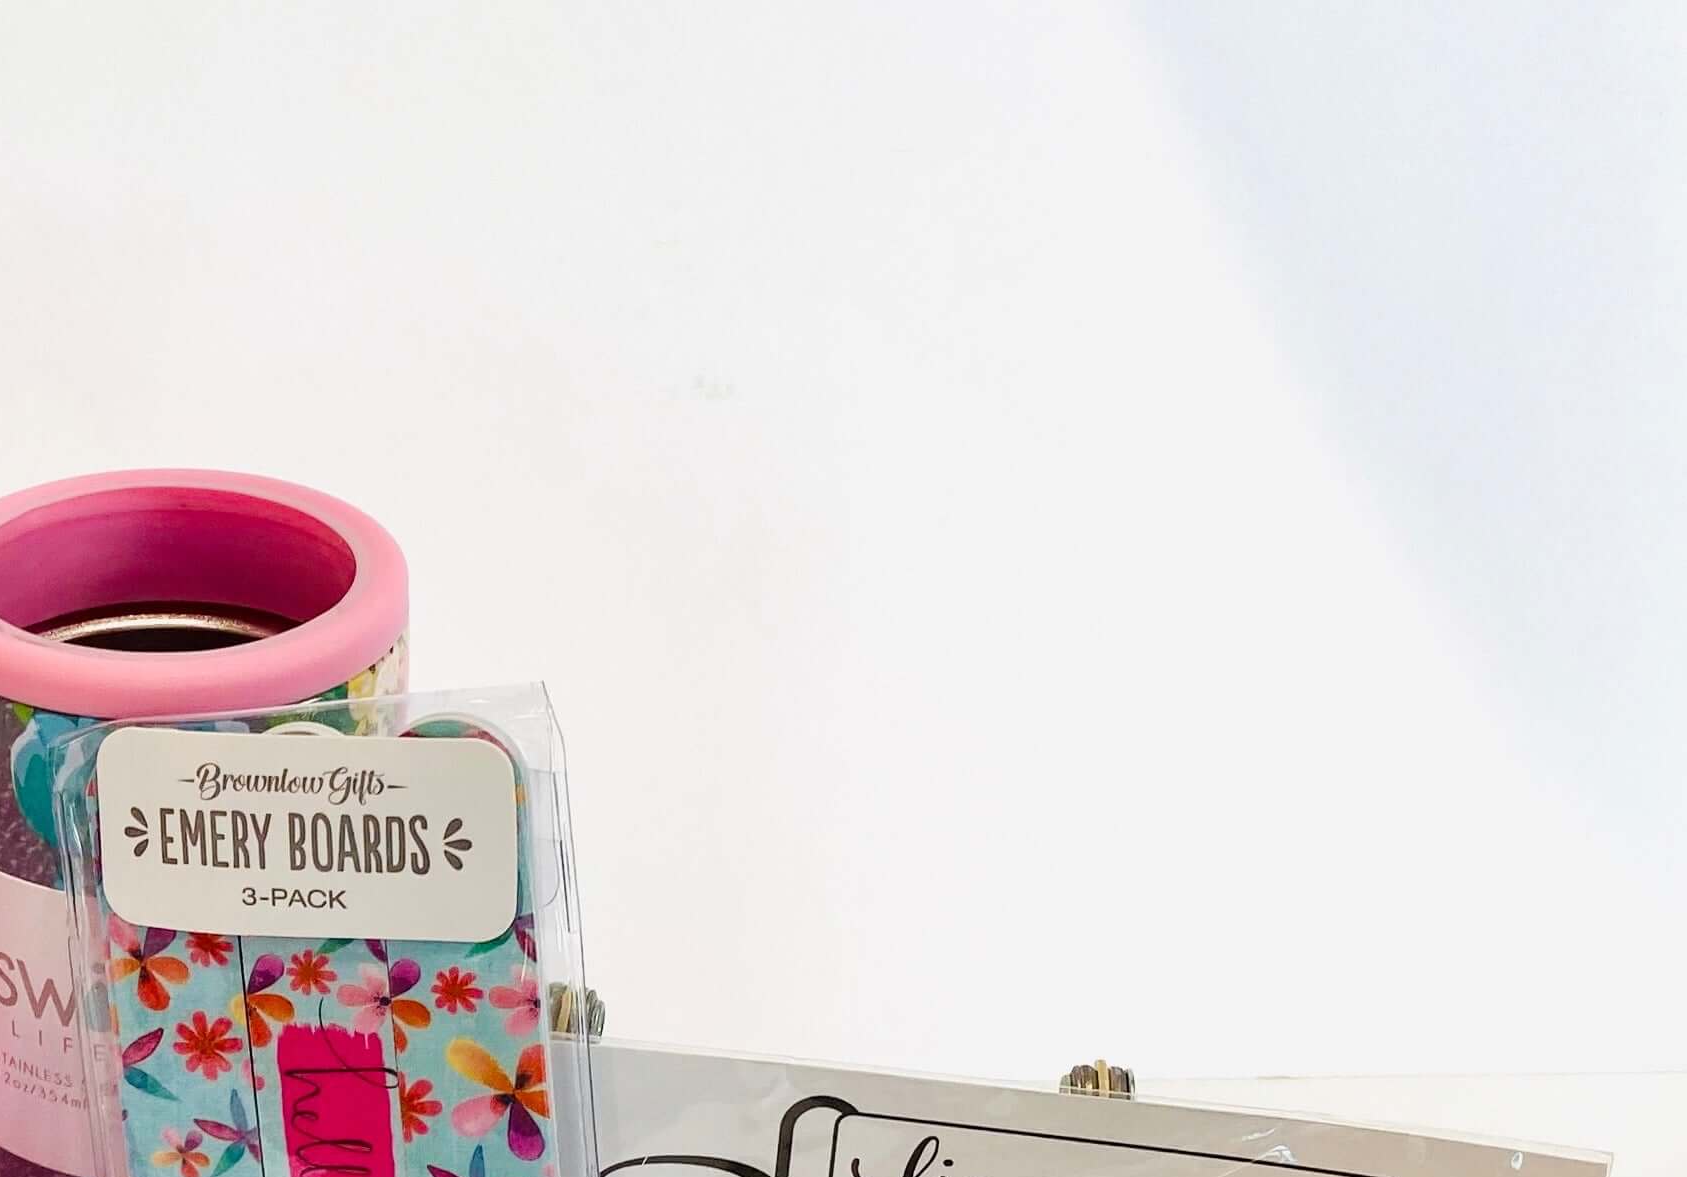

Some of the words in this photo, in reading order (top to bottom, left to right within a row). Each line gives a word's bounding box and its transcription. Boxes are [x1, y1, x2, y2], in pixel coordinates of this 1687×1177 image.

[196, 761, 325, 801] Brownlow
[322, 766, 386, 807] Gifts
[159, 806, 272, 871] EMERY
[287, 812, 431, 876] BOARDS
[241, 886, 348, 911] 3-PACK
